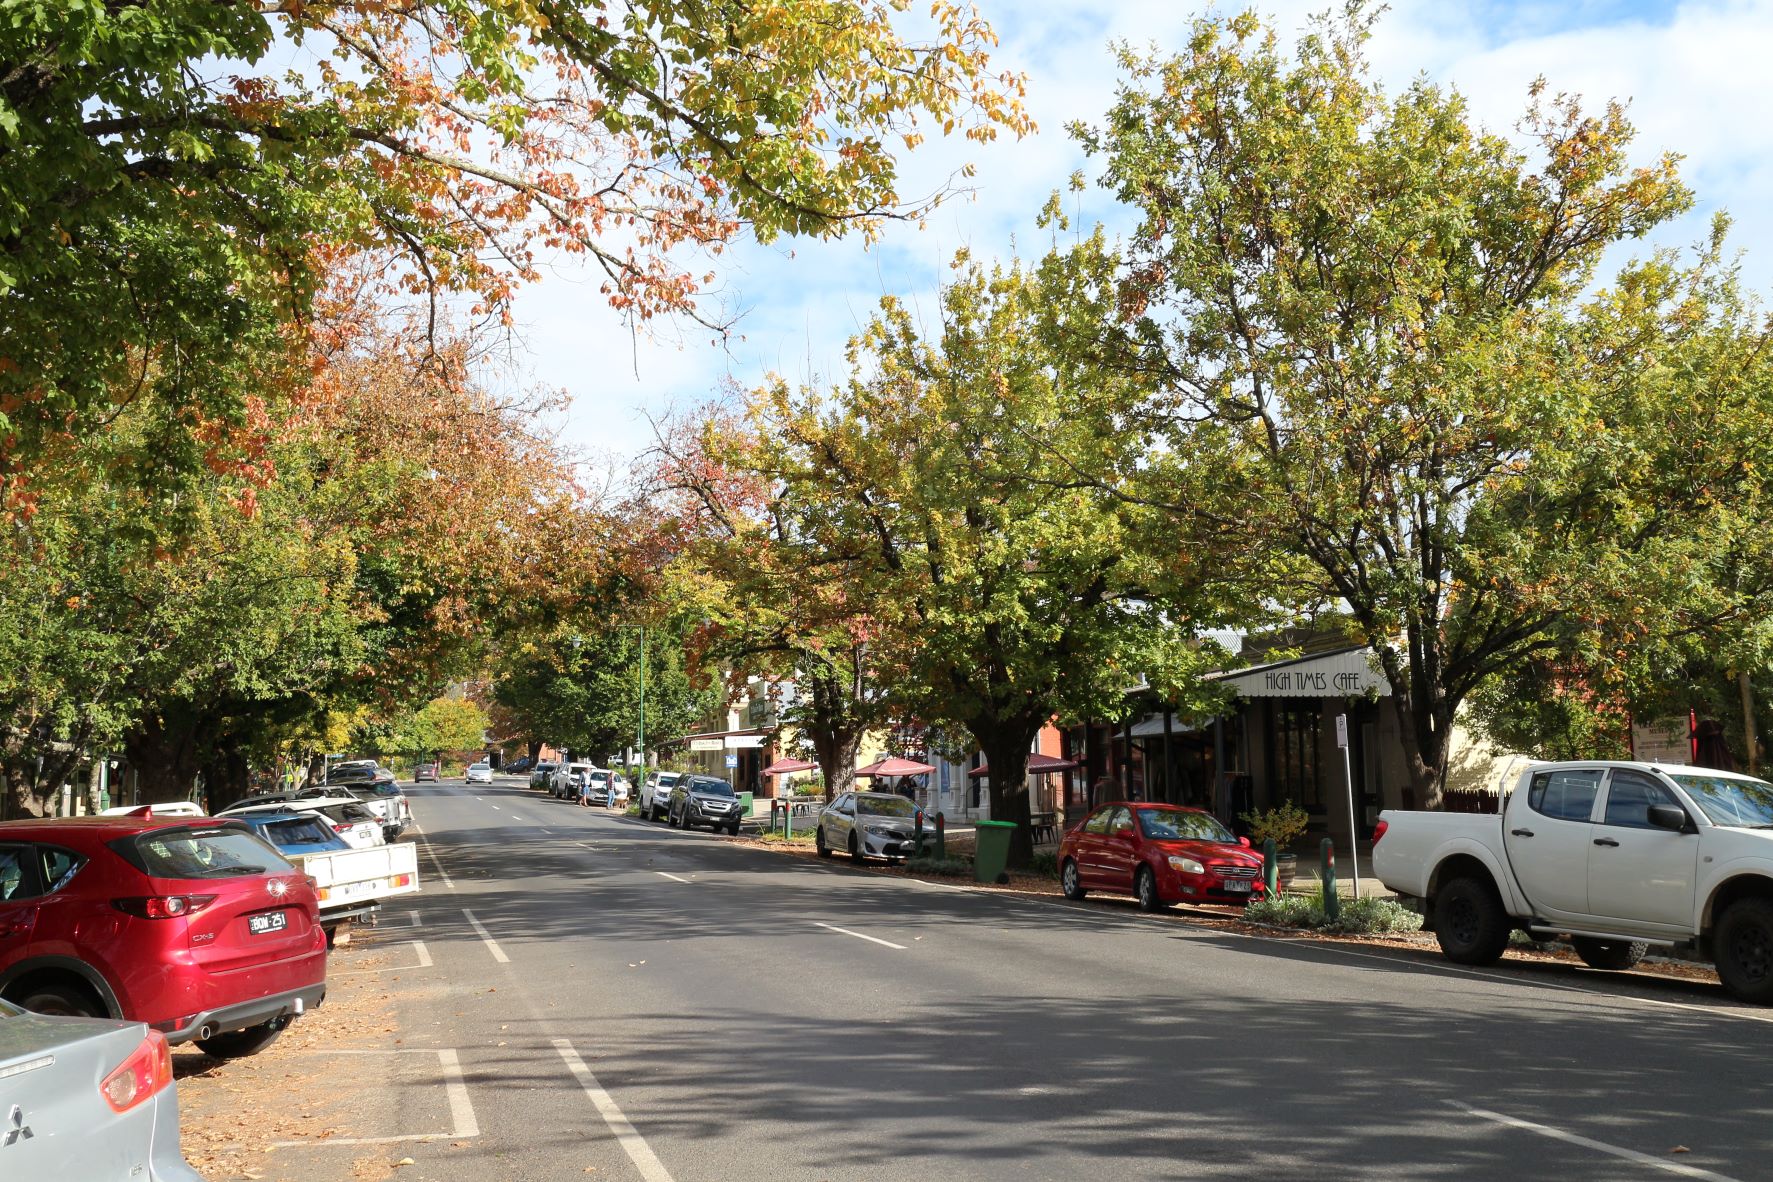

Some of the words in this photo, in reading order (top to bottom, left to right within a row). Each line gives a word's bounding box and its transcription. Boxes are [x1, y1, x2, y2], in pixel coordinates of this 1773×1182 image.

[1265, 672, 1291, 690] HIGH
[1295, 672, 1327, 690] TIMES
[1333, 672, 1360, 690] CAFE
[192, 932, 215, 942] CX-5
